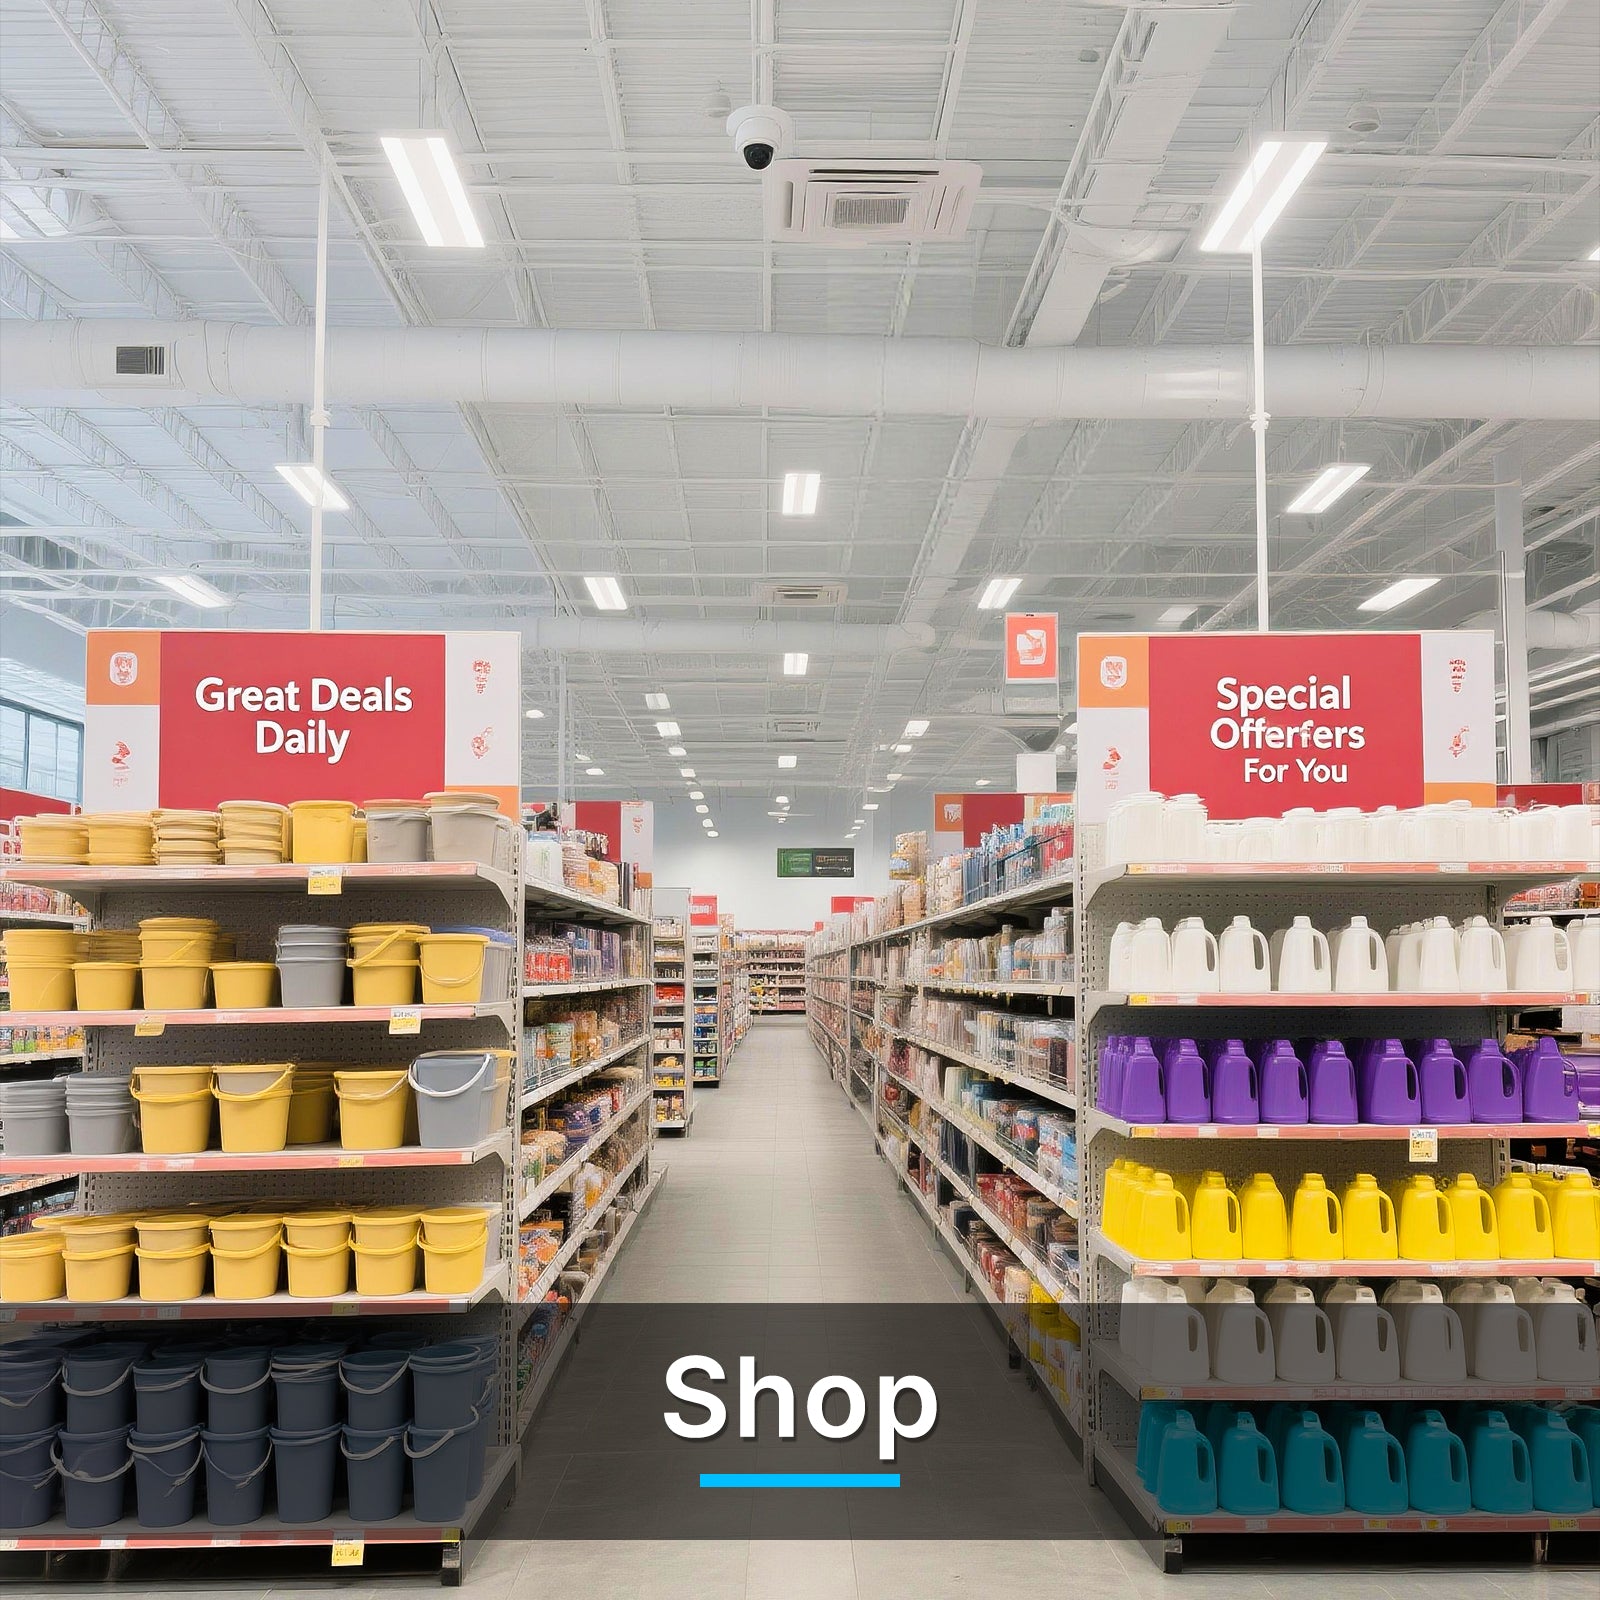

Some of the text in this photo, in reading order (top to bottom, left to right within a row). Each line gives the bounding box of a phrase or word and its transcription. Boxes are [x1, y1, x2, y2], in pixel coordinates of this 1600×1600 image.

[194, 676, 414, 713] Great Deals
[1216, 675, 1352, 718] Special
[256, 719, 352, 765] Daily
[1244, 757, 1349, 783] For You
